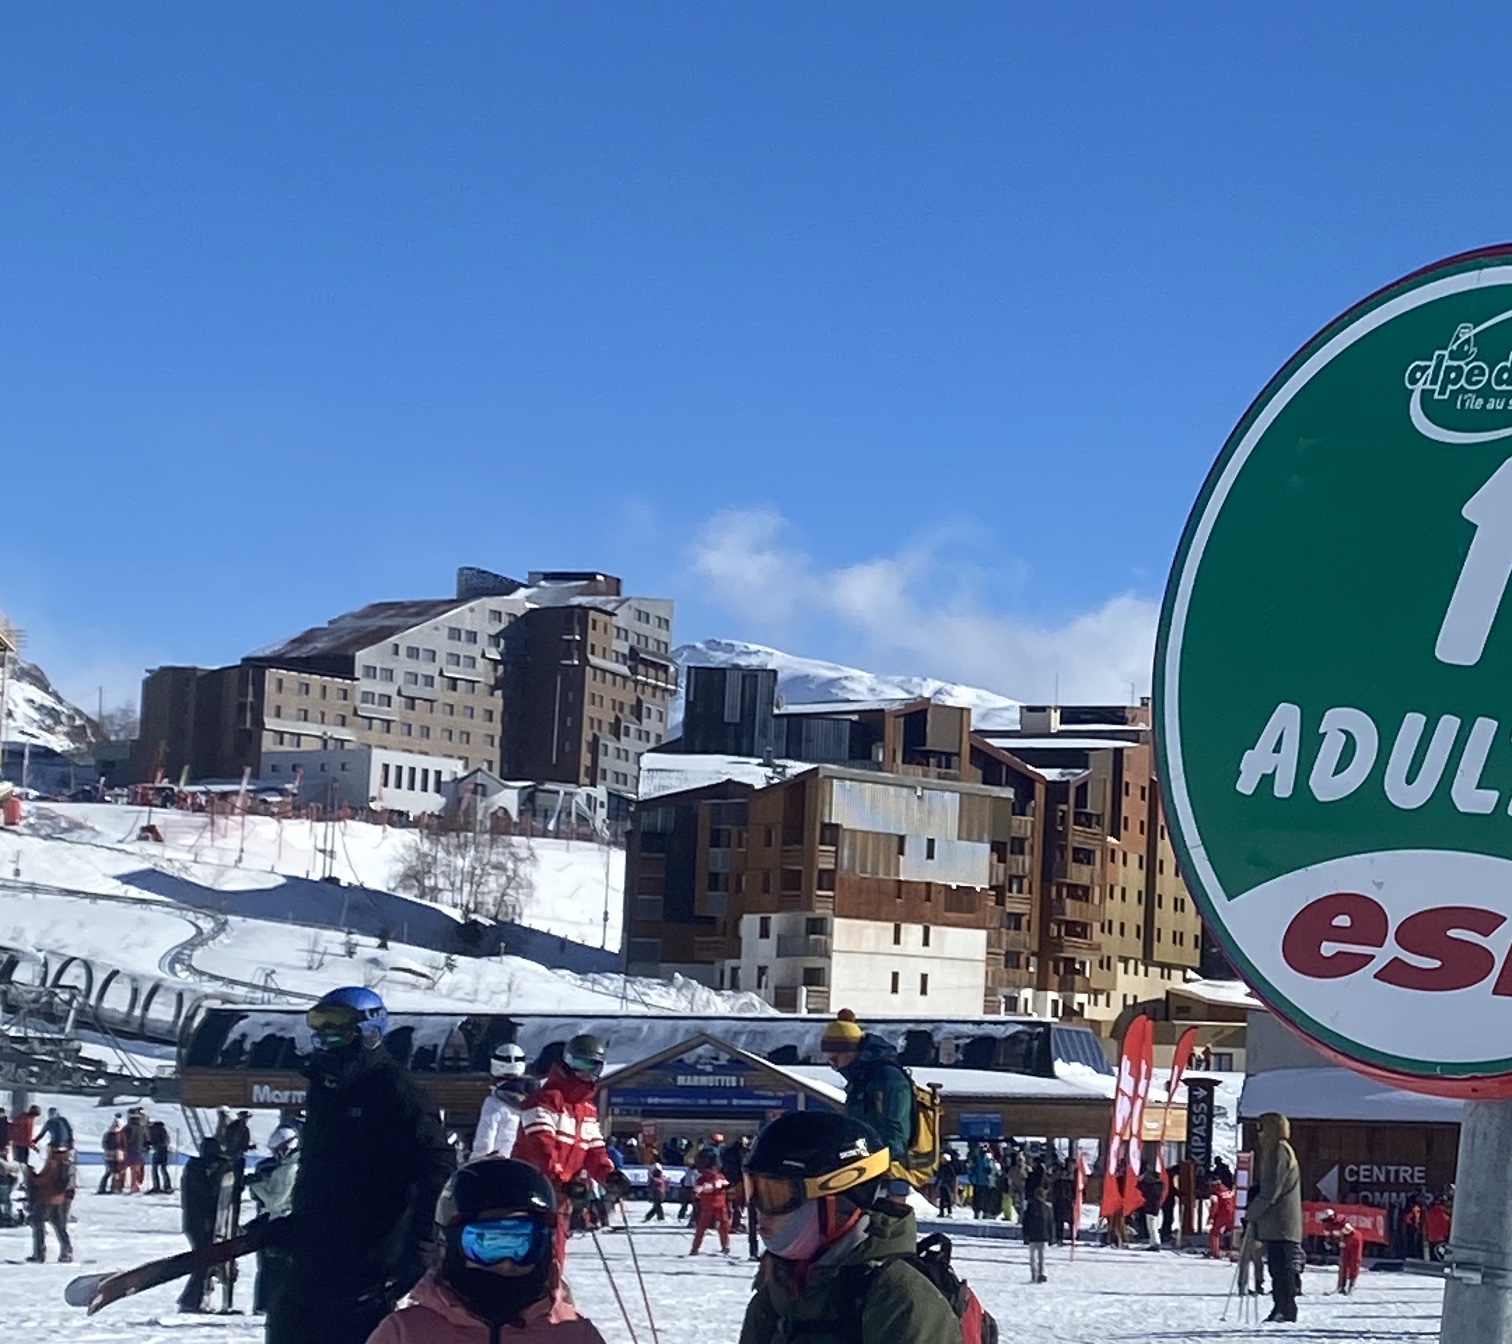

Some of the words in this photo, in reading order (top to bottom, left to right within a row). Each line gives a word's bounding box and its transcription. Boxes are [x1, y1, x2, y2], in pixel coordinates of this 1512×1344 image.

[1485, 397, 1504, 410] au
[252, 1084, 307, 1104] Marm
[1344, 1164, 1426, 1183] CENTRE
